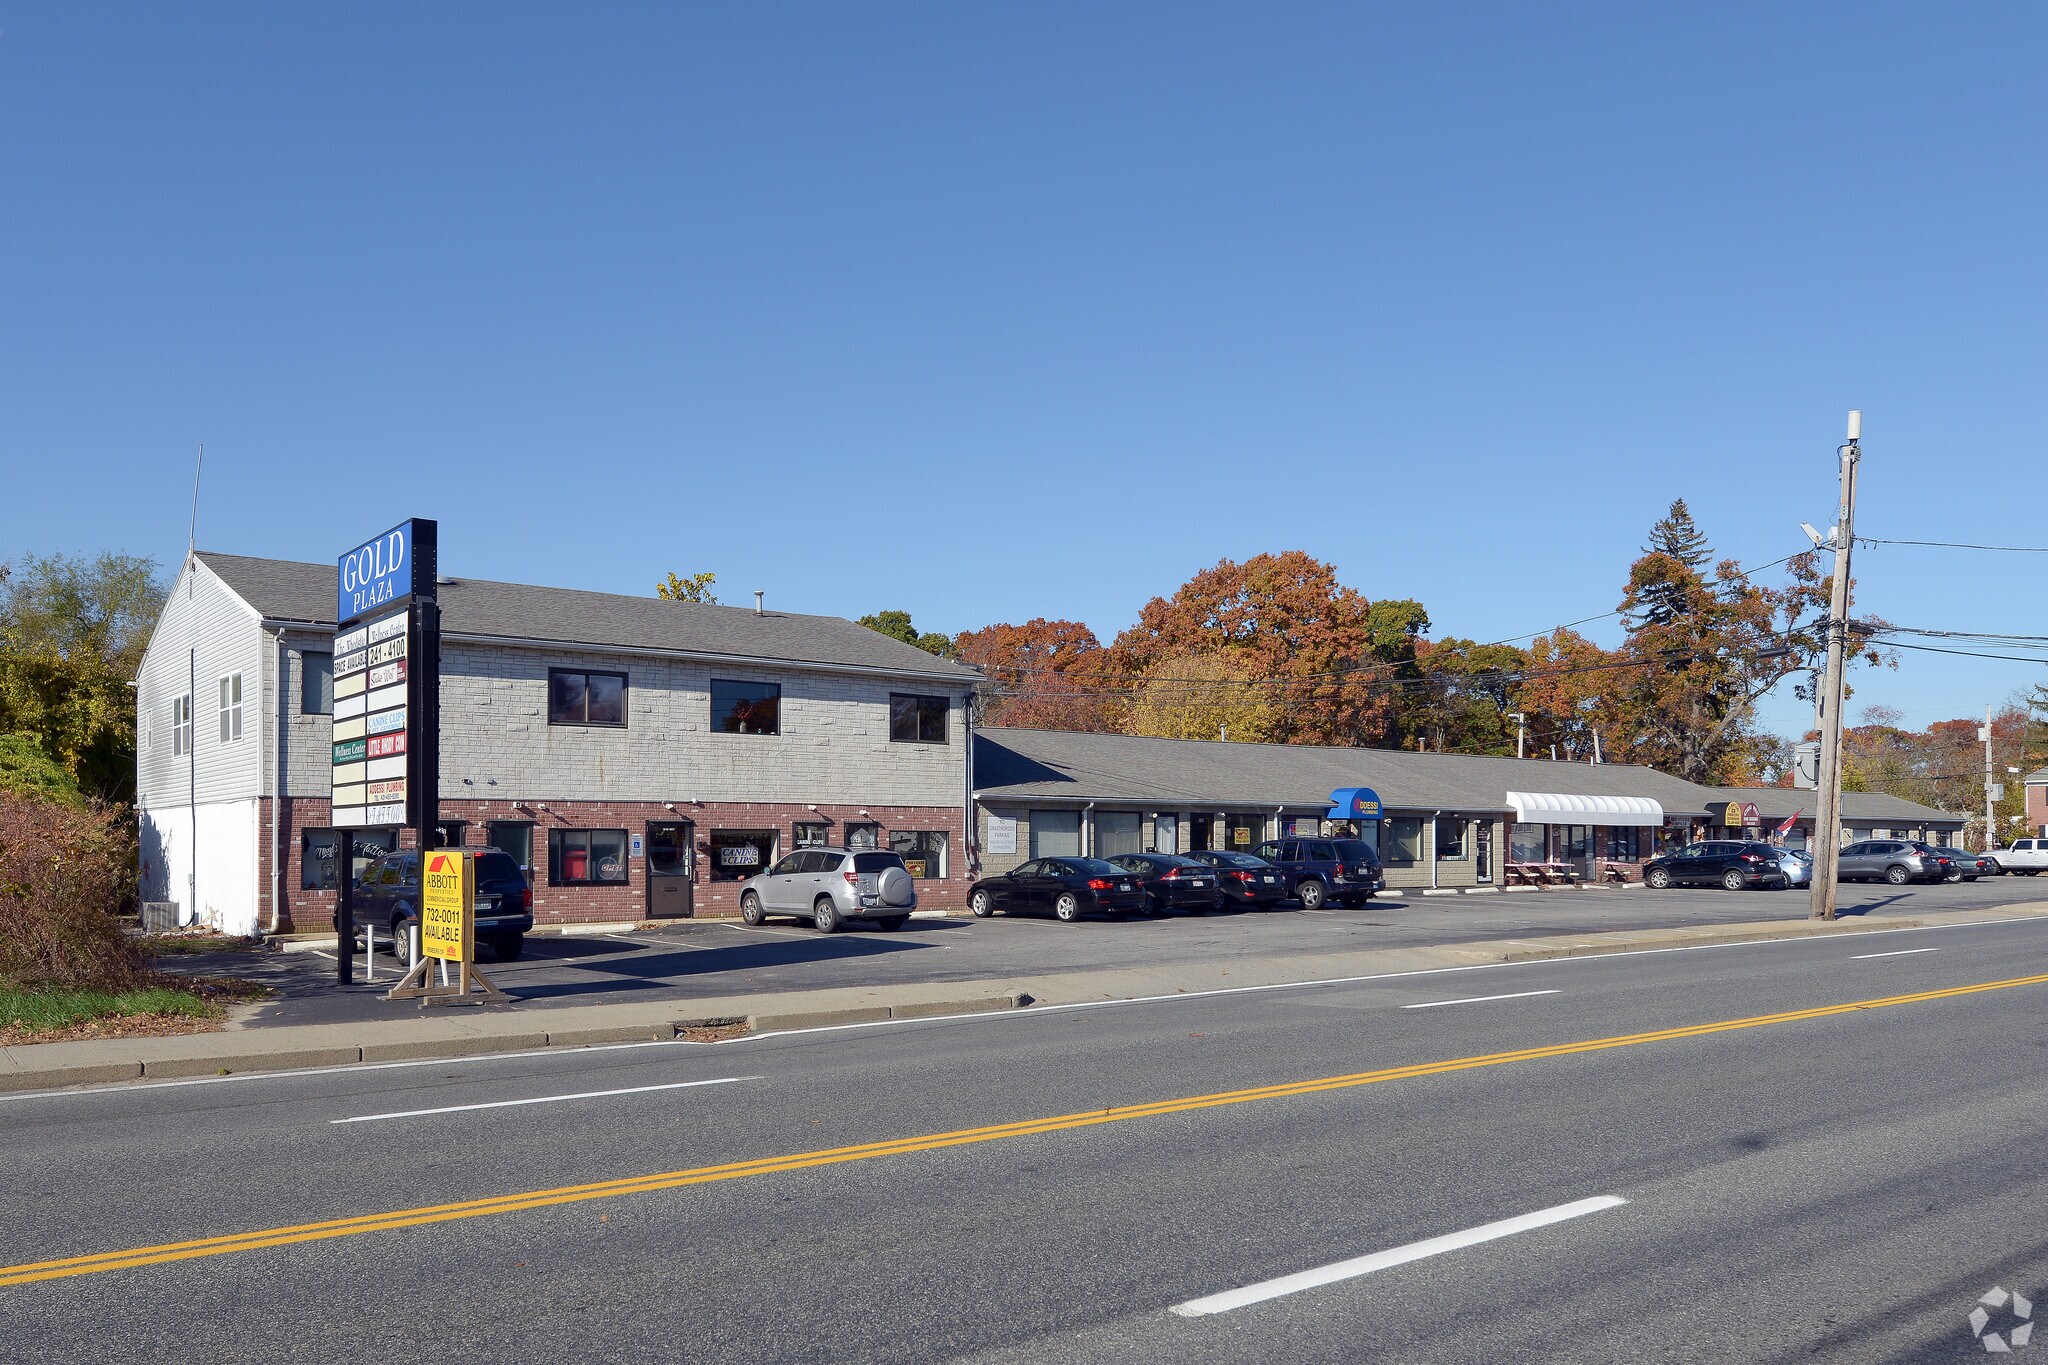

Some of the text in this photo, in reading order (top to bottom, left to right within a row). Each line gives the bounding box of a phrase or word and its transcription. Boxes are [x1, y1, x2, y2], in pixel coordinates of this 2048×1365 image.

[344, 530, 404, 593] GOLD
[353, 578, 393, 614] PLAZA
[390, 619, 405, 636] Center
[370, 646, 382, 665] 241
[388, 638, 405, 659] 4100
[334, 651, 367, 675] SPACE AVAILABLE
[368, 710, 405, 729] CANINE CLIPS
[335, 743, 366, 758] Wellness Center
[368, 738, 380, 756] LITTLE
[369, 781, 404, 795] ADDESSI PLUMBING
[722, 848, 758, 857] CANINE
[601, 864, 623, 872] OPEN
[427, 874, 458, 889] ABBOTT
[426, 907, 460, 924] 732-0011
[425, 924, 460, 942] AVAILABLE
